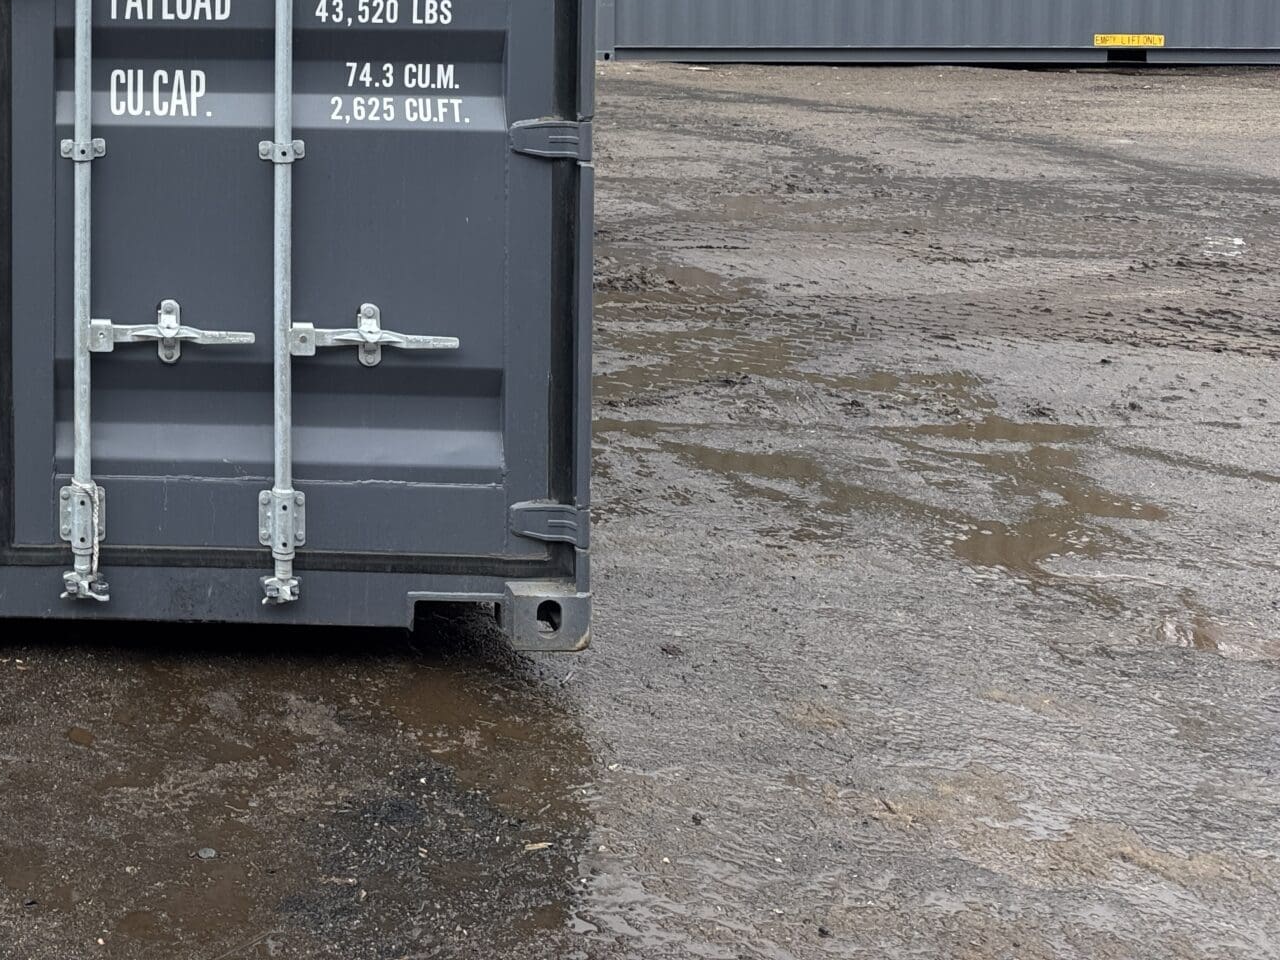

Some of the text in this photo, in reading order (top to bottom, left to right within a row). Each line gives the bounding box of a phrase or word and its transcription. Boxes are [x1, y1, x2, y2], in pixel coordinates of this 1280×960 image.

[110, 62, 460, 118] CU.CAP. 74.3 CU.M.
[330, 96, 471, 124] 2,625 CU.FT.
